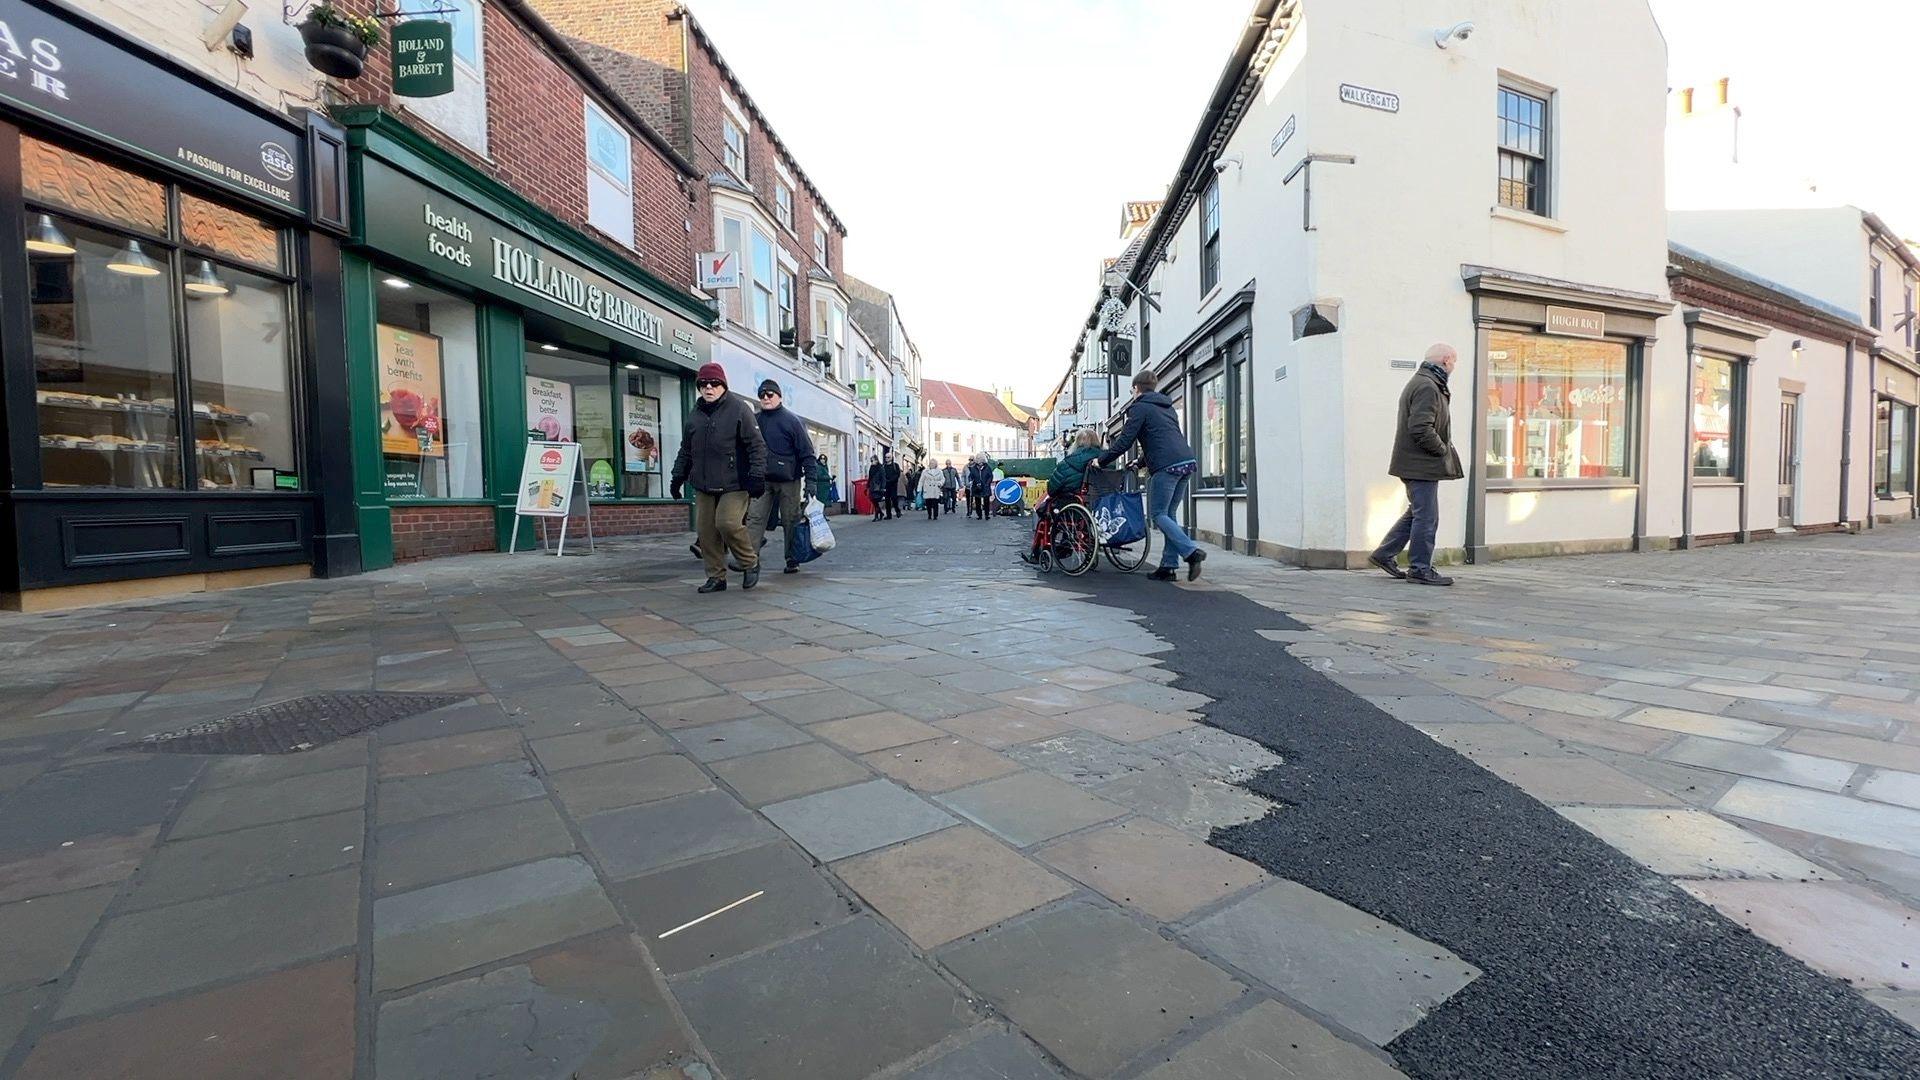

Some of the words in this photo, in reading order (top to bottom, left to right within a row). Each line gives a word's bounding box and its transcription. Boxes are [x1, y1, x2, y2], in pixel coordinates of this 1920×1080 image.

[398, 38, 444, 53] HOLLAND
[416, 51, 426, 63] &
[398, 62, 444, 78] BARRETT
[1343, 87, 1396, 109] WALKERGATE
[261, 151, 294, 173] taste
[178, 147, 185, 159] A
[186, 150, 224, 175] PASSION
[226, 167, 243, 182] FOR
[244, 174, 291, 201] EXCELLENCE
[424, 203, 472, 243] health
[427, 232, 472, 267] foods
[707, 274, 734, 284] savers
[490, 237, 585, 307] HOLLAND
[586, 284, 602, 320] &
[604, 291, 664, 346] BARRETT
[1552, 315, 1579, 328] HUGH
[394, 342, 414, 357] Teas
[671, 343, 698, 361] remedies
[394, 357, 416, 369] with
[386, 364, 423, 382] benefits
[539, 405, 559, 414] better
[541, 398, 556, 408] only
